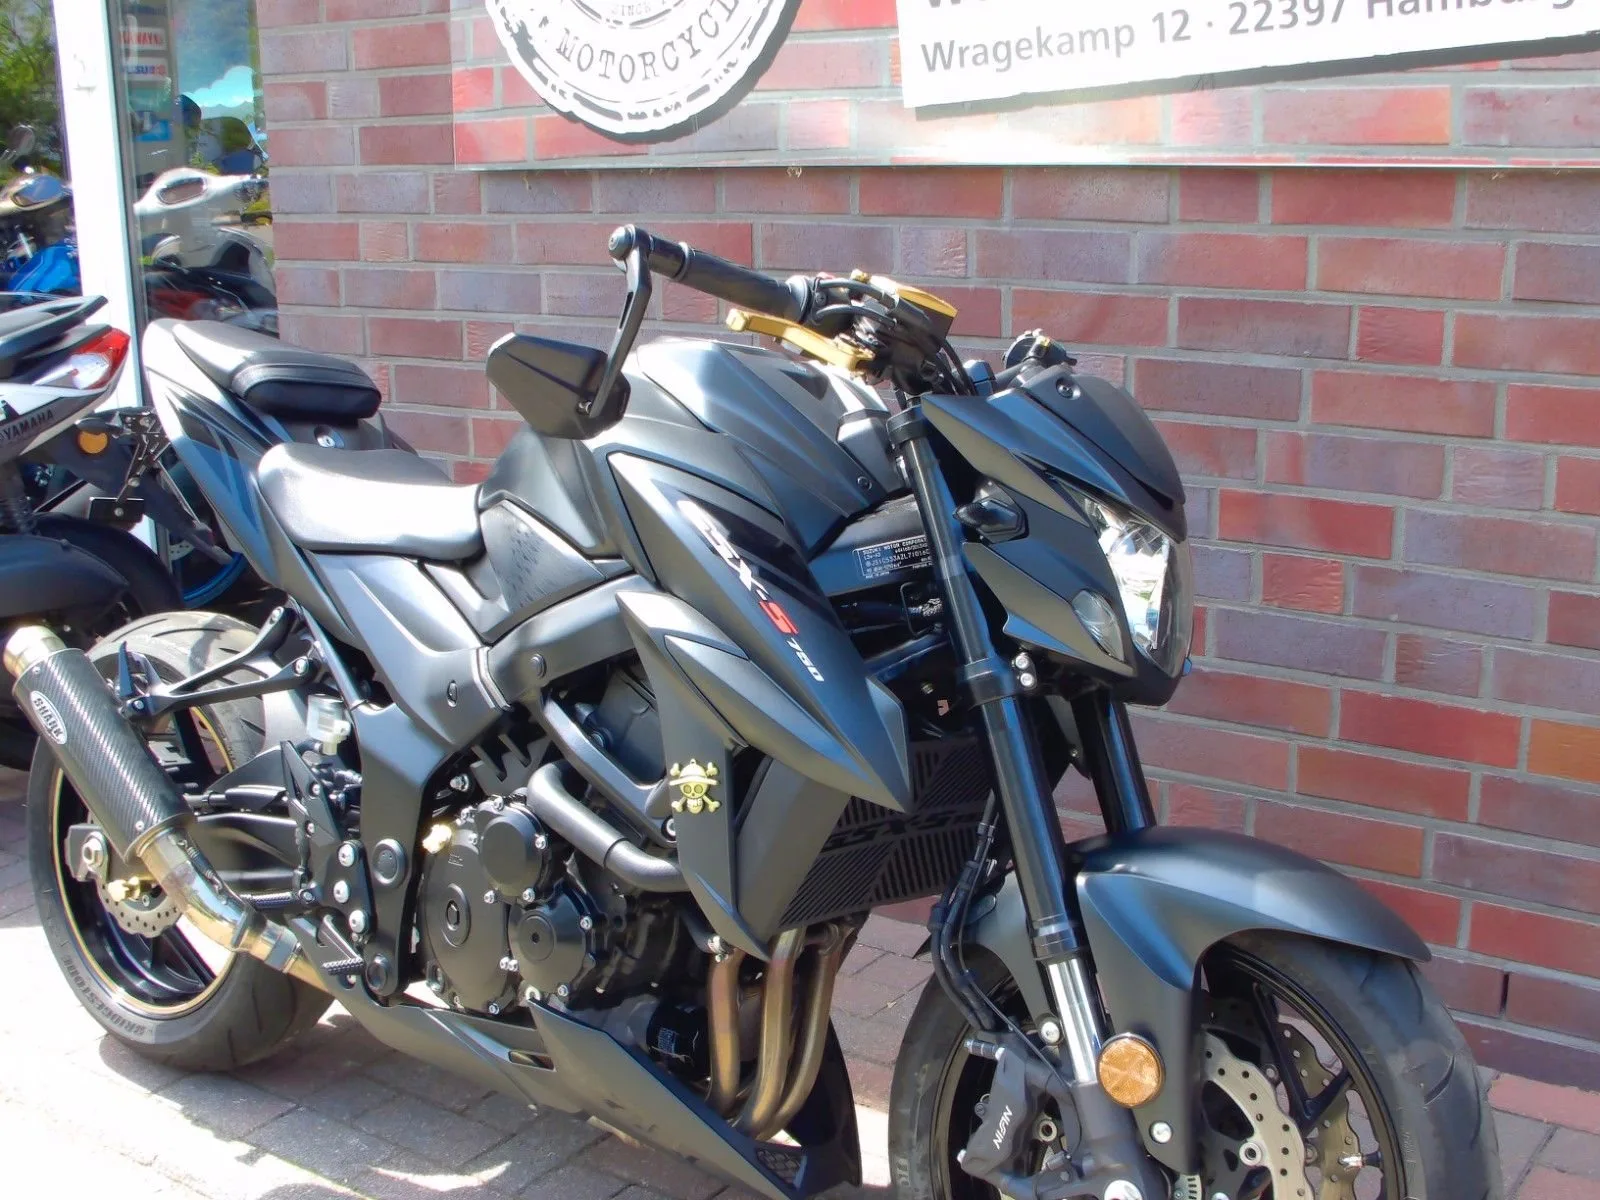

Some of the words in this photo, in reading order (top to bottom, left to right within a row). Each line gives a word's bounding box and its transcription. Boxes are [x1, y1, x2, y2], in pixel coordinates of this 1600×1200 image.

[921, 23, 1135, 72] Wragekamp
[1152, 9, 1191, 43] 12
[1229, 0, 1344, 35] 22397
[3, 409, 54, 440] YAMAHA
[786, 637, 824, 681] 750
[34, 698, 64, 738] SHARK
[992, 1105, 1012, 1150] NISSIN
